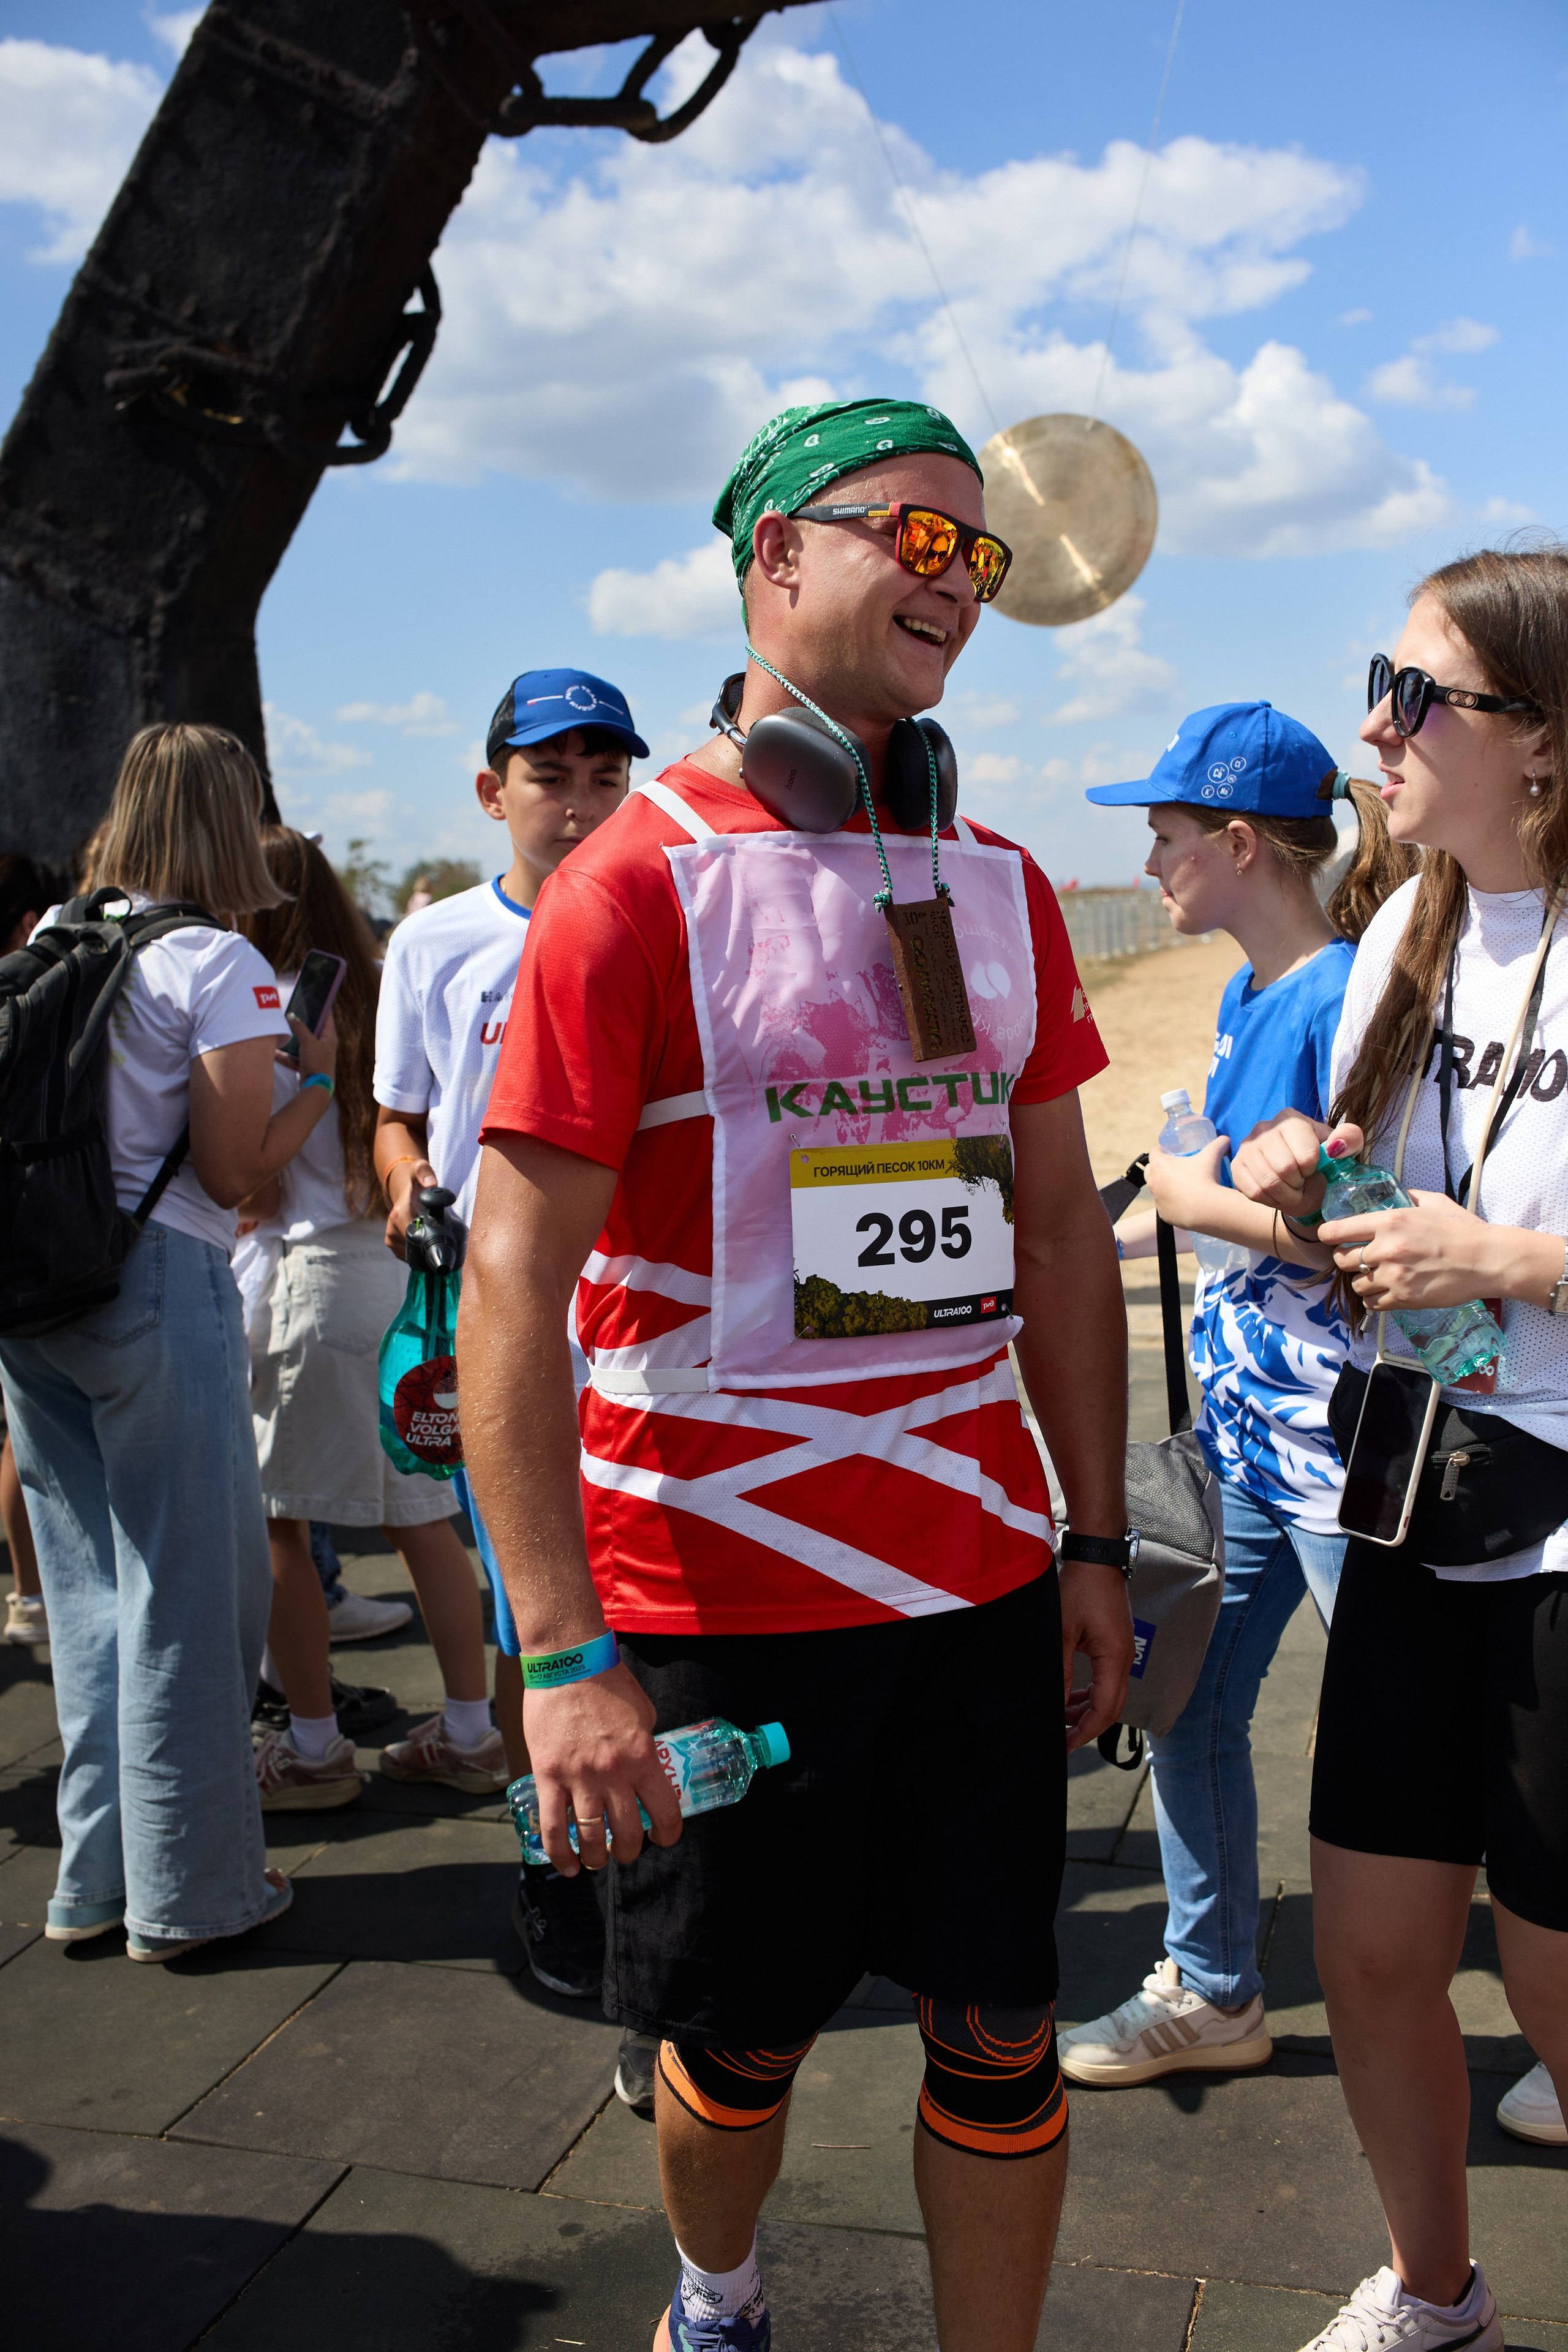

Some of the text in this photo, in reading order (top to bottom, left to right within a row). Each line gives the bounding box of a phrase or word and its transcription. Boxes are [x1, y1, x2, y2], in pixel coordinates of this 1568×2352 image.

[833, 507, 865, 515] SHIMANO
[813, 1159, 944, 1177] ГОРЯЩИЙ ПЕСОК 10КМ
[856, 1205, 971, 1267] 295
[934, 1305, 972, 1318] ULTRA100
[412, 1411, 459, 1424] ELTON
[410, 1422, 460, 1436] VOLGA
[406, 1433, 451, 1447] ULTRA
[527, 1653, 584, 1673] ULTRA100
[543, 1670, 570, 1679] АВГУСТА
[570, 1664, 586, 1673] 2025
